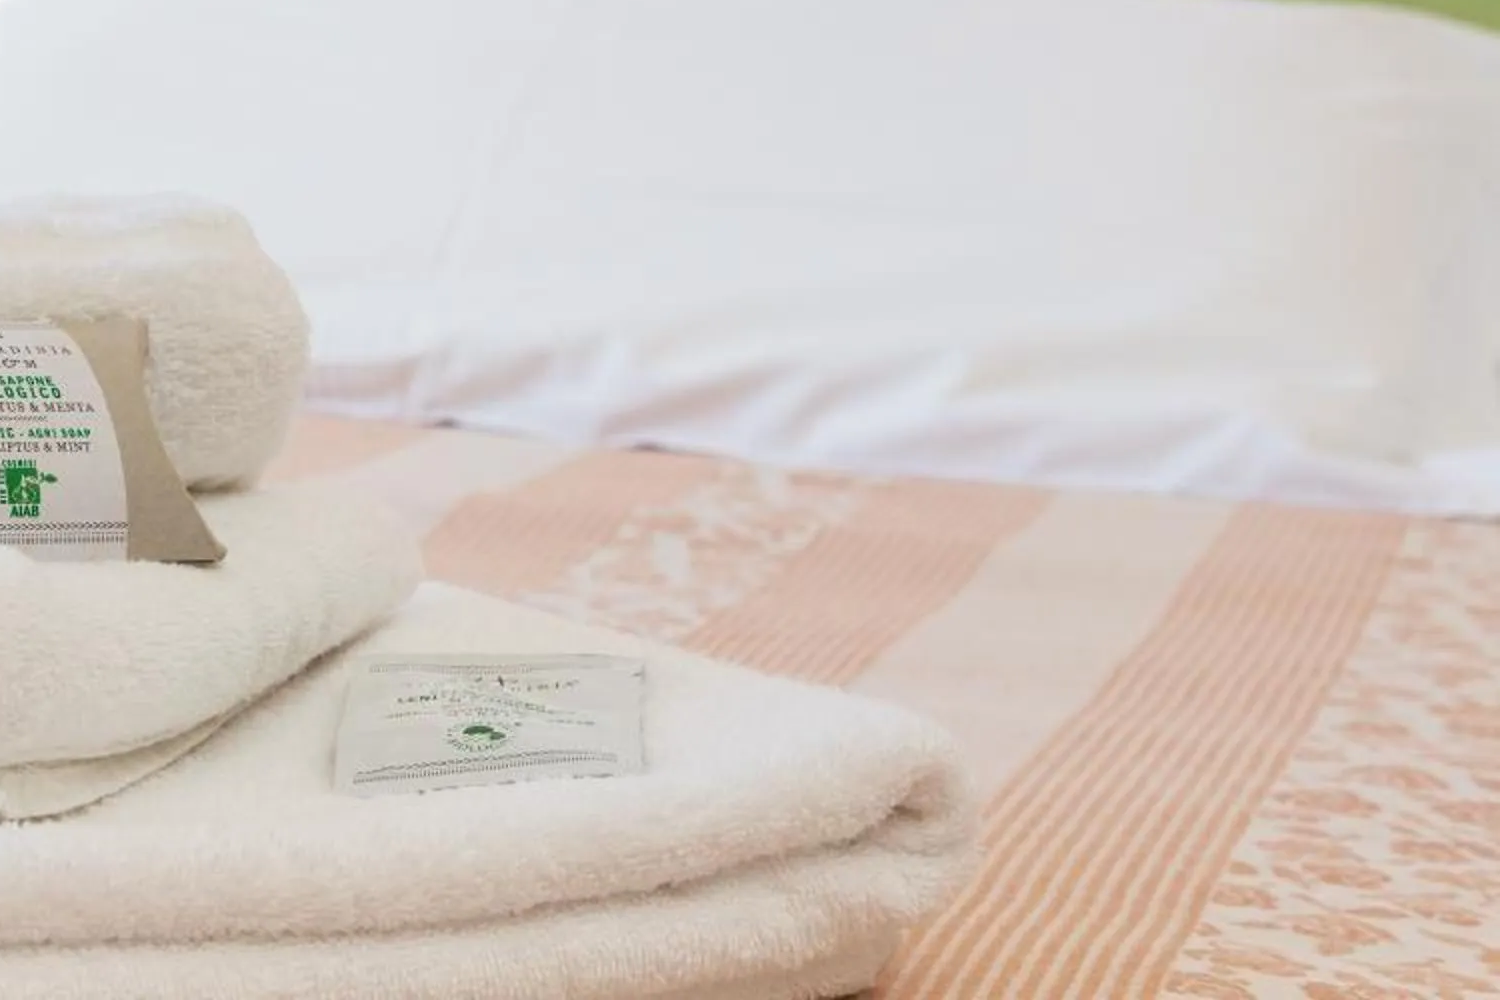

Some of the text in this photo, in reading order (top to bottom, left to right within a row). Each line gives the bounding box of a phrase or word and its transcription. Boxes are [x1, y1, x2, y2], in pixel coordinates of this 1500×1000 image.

[29, 402, 40, 413] &
[44, 402, 95, 413] MENTA
[60, 428, 92, 439] SOAP
[42, 442, 54, 453] &
[56, 441, 92, 453] MINT
[10, 505, 41, 518] AIAB
